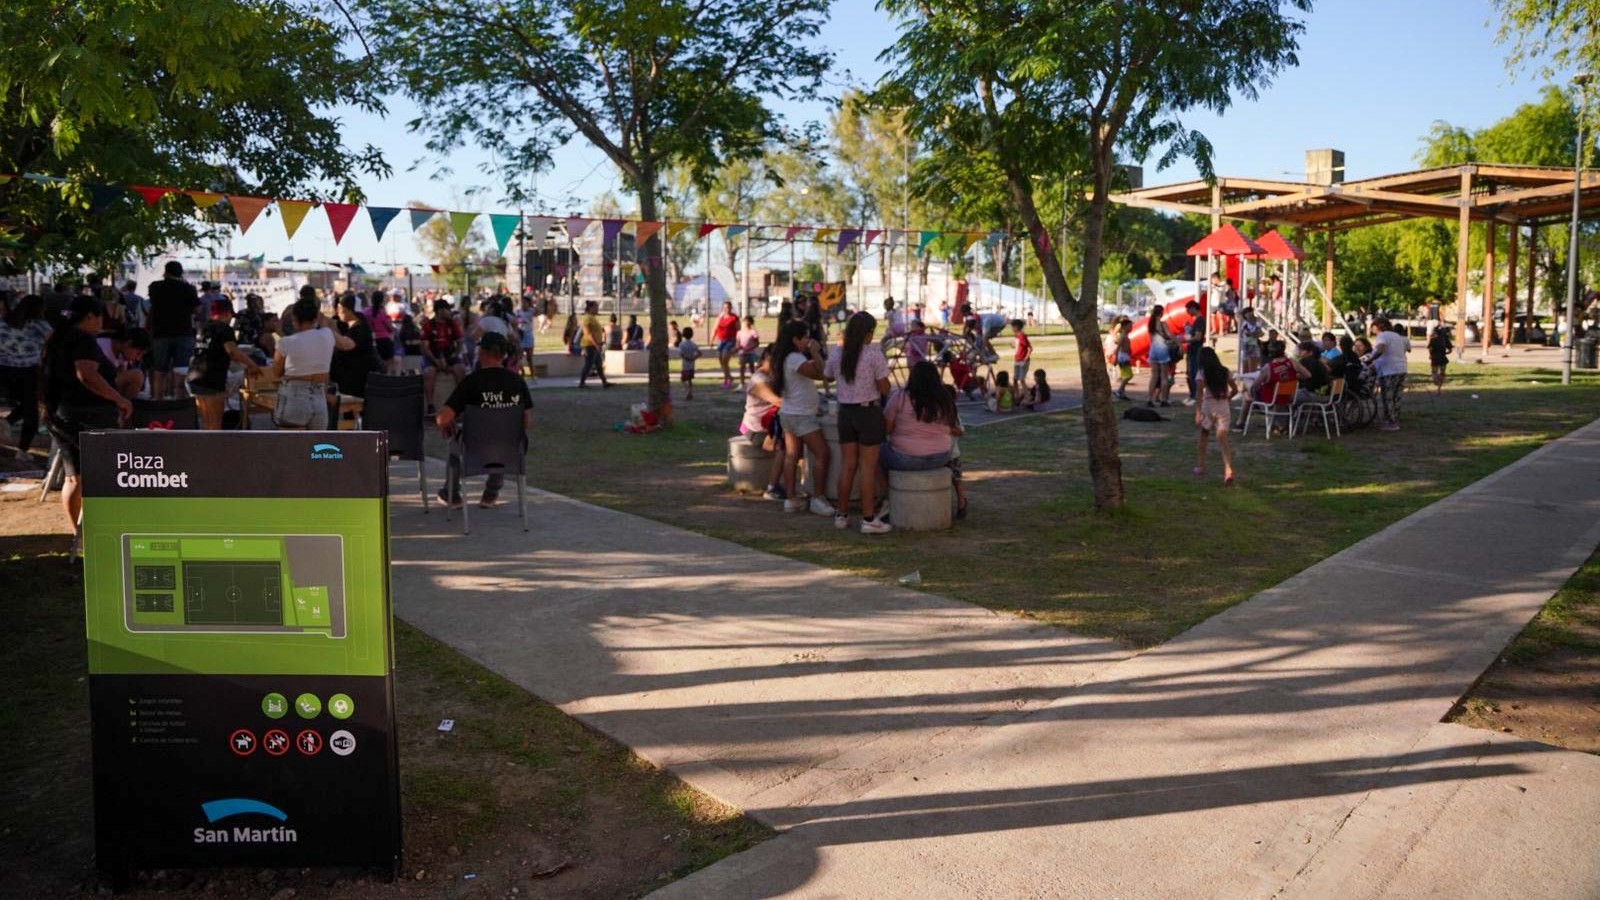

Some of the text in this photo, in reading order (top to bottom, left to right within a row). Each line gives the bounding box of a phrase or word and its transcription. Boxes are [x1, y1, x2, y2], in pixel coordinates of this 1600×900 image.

[117, 452, 164, 469] Plaza
[117, 471, 188, 488] Combet
[193, 825, 297, 843] San Martín
